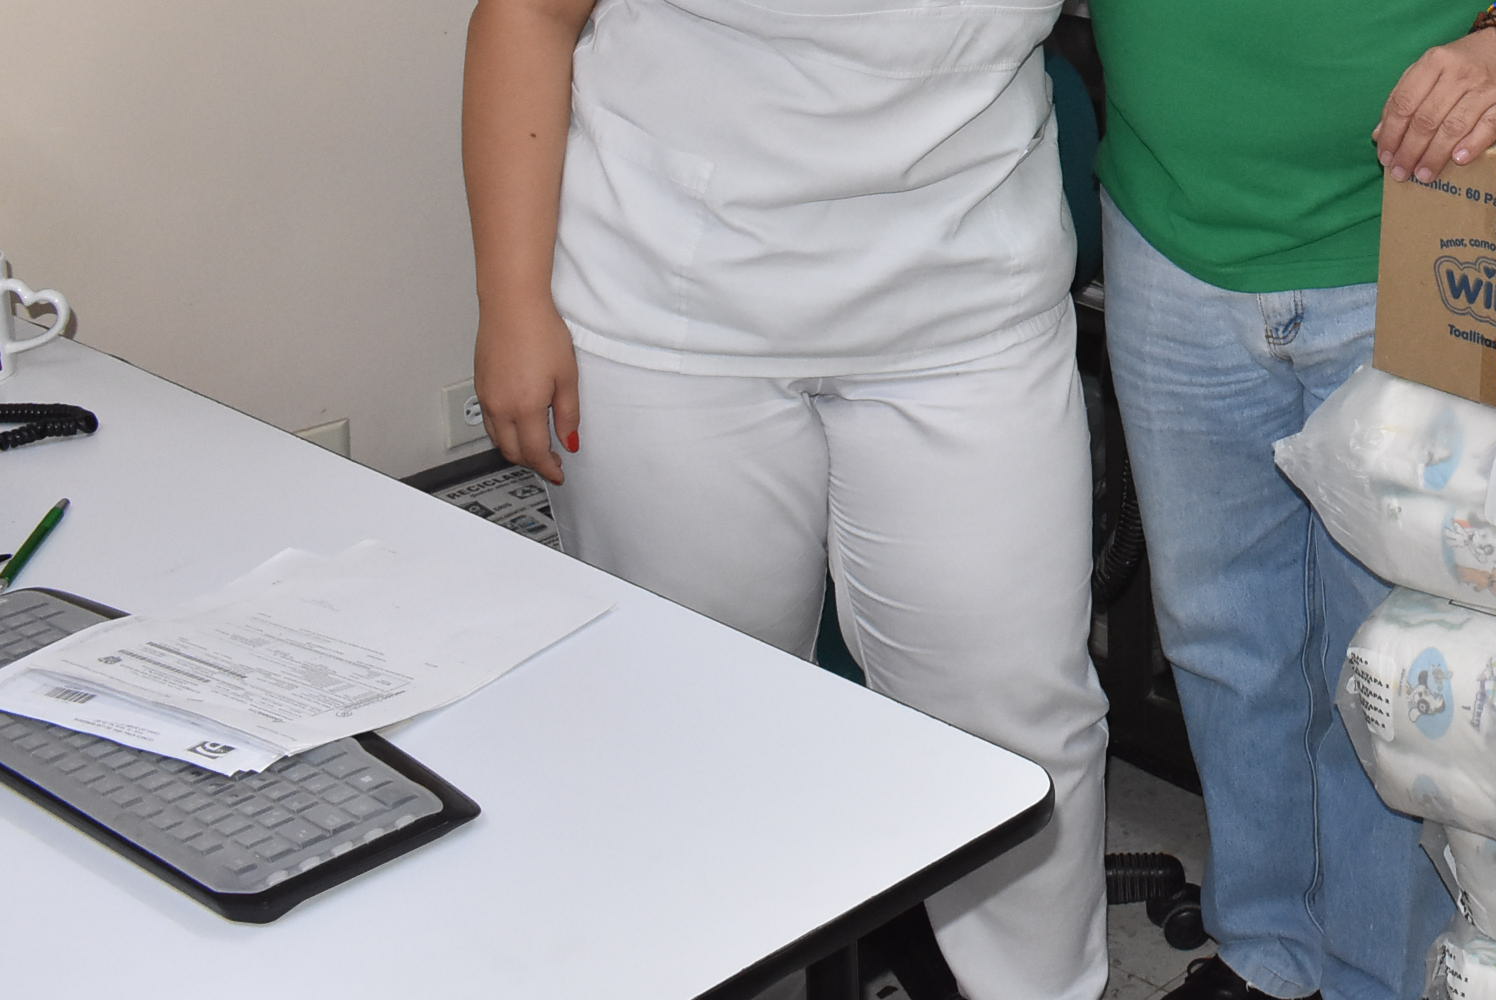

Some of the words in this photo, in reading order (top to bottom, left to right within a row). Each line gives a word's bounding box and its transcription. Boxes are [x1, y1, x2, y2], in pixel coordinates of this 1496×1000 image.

[1466, 187, 1480, 201] 60
[1440, 238, 1467, 250] Amor,
[1469, 238, 1496, 251] como
